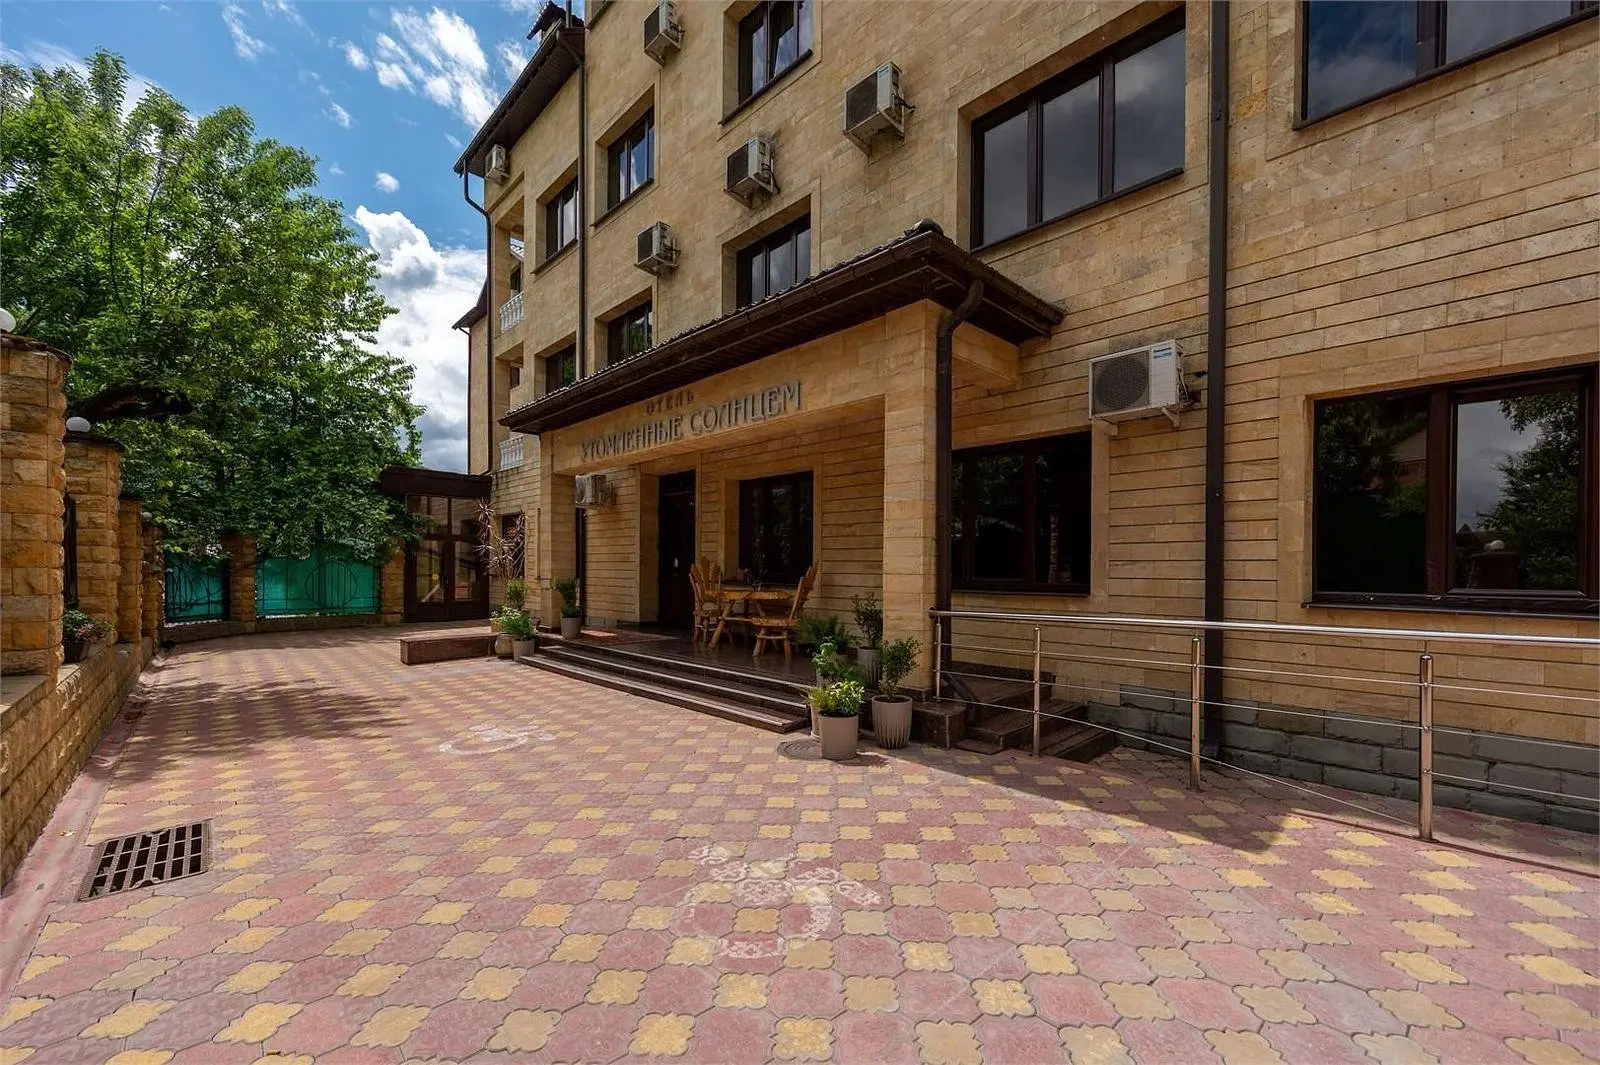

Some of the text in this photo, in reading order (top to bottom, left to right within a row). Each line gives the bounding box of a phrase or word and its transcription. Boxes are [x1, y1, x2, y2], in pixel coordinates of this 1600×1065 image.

[581, 381, 801, 462] УТОМЛЕННЫЕ СОЛНЦЕМ
[646, 389, 694, 414] ОТЕЛЬ
